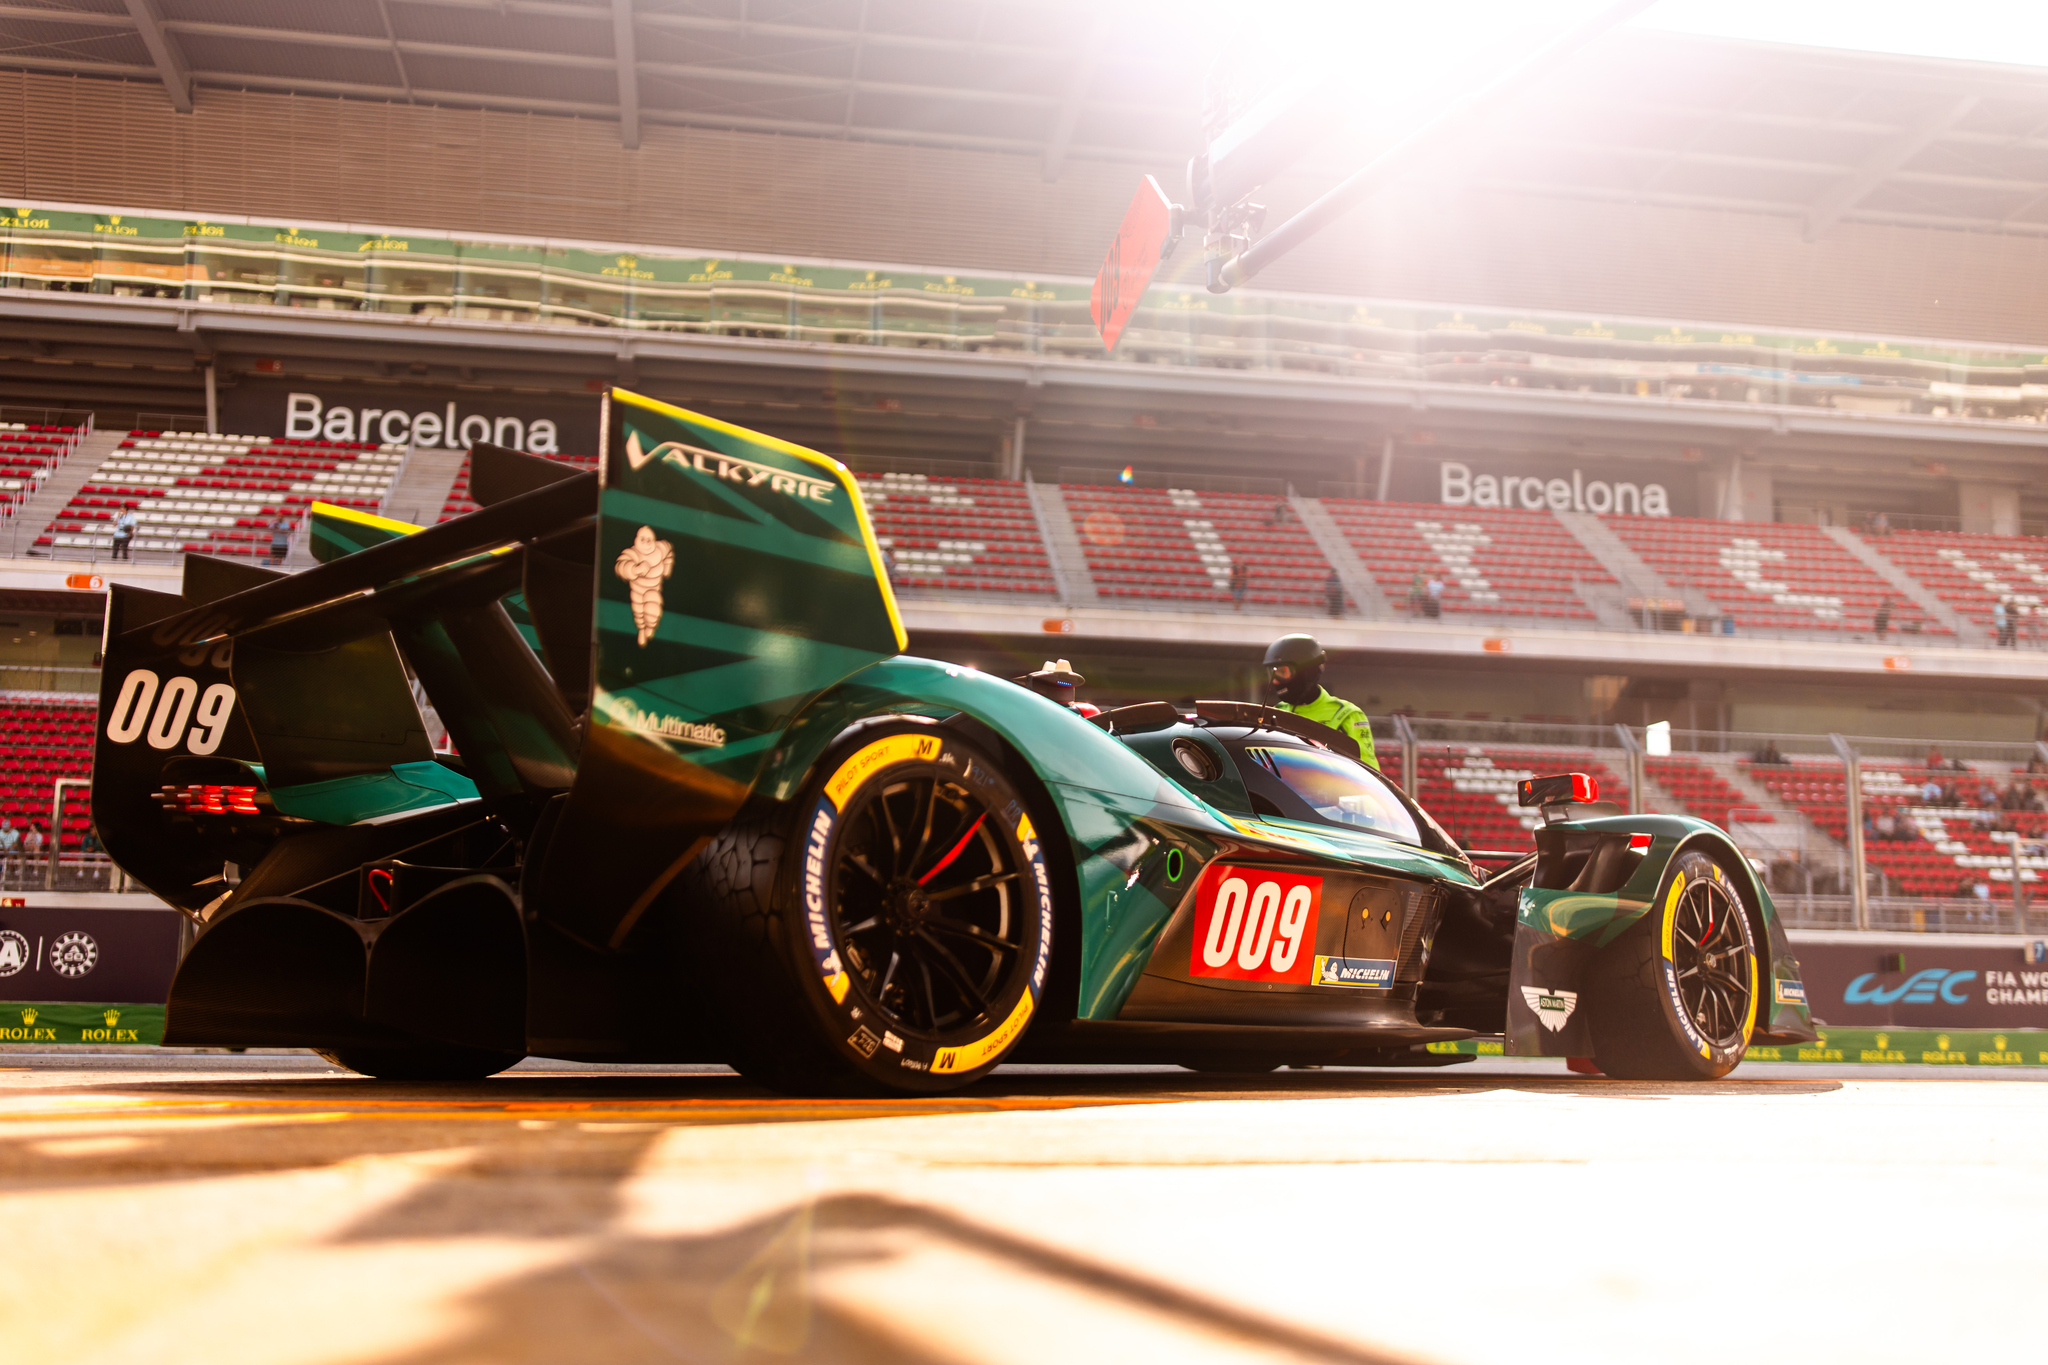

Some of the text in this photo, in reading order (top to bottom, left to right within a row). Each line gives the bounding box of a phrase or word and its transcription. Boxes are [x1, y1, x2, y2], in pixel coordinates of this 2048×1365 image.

[285, 392, 560, 453] Barcelona
[625, 430, 836, 505] VALKYRIE
[1441, 462, 1670, 516] Barcelona
[106, 668, 236, 756] 009
[636, 709, 727, 743] Multimatic
[835, 738, 933, 794] PILOT SPORT M
[805, 809, 833, 950] MICHELIN
[1033, 862, 1052, 989] MICHELIN
[1203, 877, 1312, 973] 009
[1725, 883, 1755, 948] MICHELIN
[1339, 966, 1391, 981] MICHELIN
[1843, 968, 1977, 1005] WEC
[1985, 970, 2018, 988] FIA
[1010, 1004, 1029, 1034] PILOT
[1666, 968, 1701, 1043] MICHELIN
[0, 1027, 57, 1041] ROLEX
[81, 1028, 139, 1042] ROLEX
[981, 1030, 1008, 1056] SPORT
[1798, 1048, 1844, 1062] ROLEX
[1860, 1049, 1906, 1063] ROLEX
[1922, 1051, 1967, 1063] ROLEX
[1978, 1051, 2023, 1064] ROLEX
